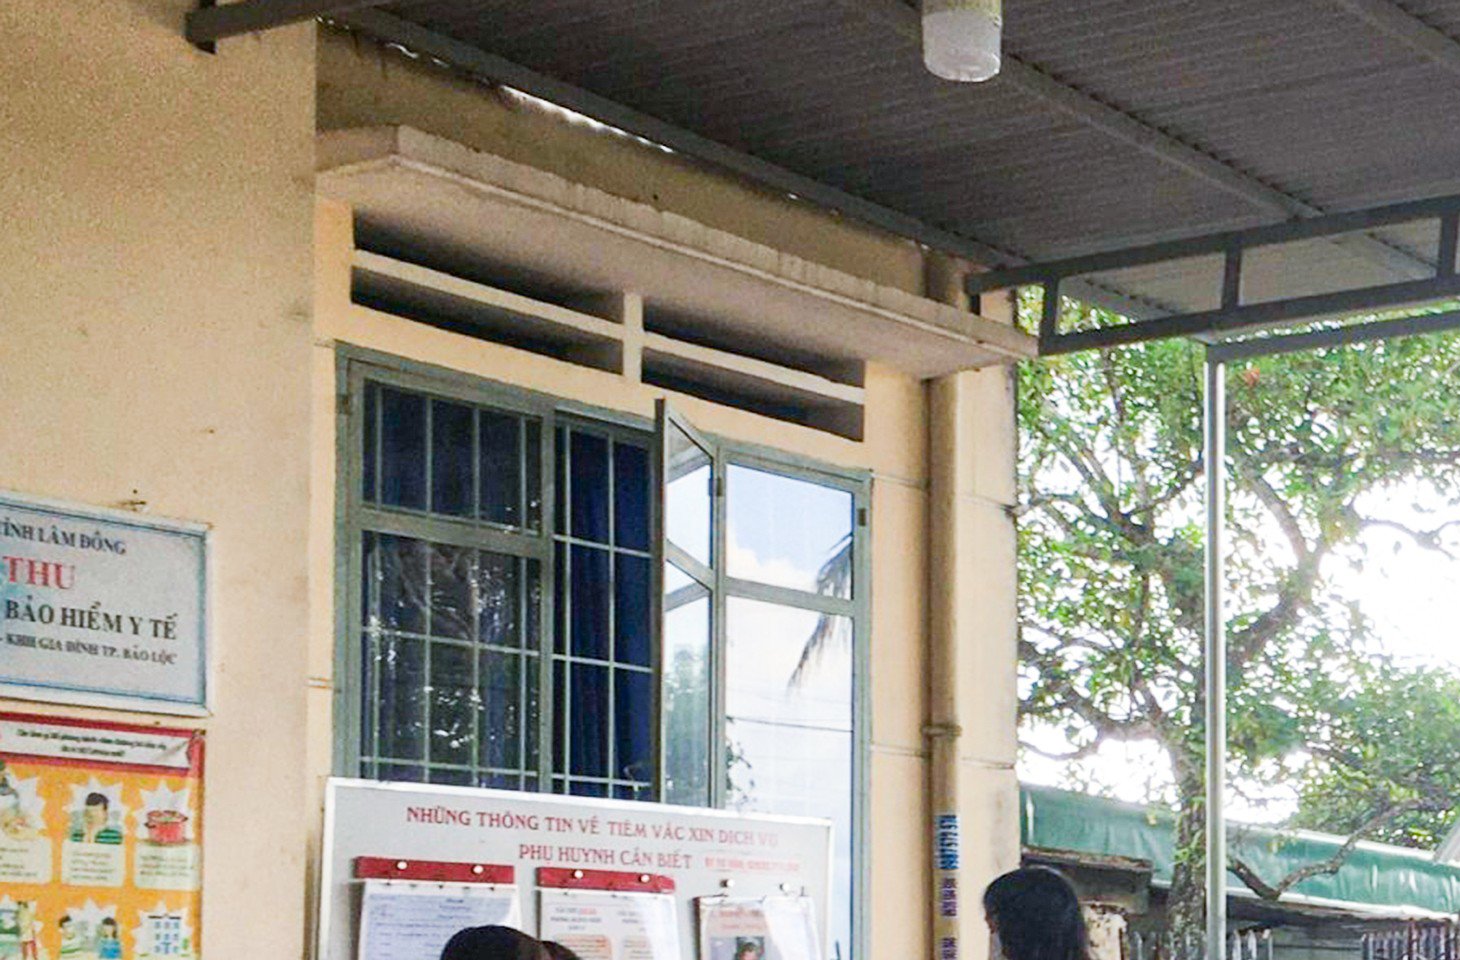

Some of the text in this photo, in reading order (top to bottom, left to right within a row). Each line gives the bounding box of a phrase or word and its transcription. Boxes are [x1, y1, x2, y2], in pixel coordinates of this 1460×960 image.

[0, 517, 127, 555] ỈNH LÂM ĐỒNG
[2, 556, 75, 590] THU
[5, 595, 178, 640] BẢO HIỂM Y TẾ
[39, 638, 62, 651] GIA
[123, 645, 149, 661] BẢO
[152, 649, 178, 665] LỘC
[407, 806, 471, 826] NHỮNG
[476, 811, 539, 830] THÔNG
[545, 817, 572, 832] TIN
[608, 819, 647, 838] TIÊM
[688, 828, 714, 843] XIN
[519, 844, 553, 865] PHỤ
[558, 846, 614, 866] HUYNH
[657, 852, 692, 869] BIẾT
